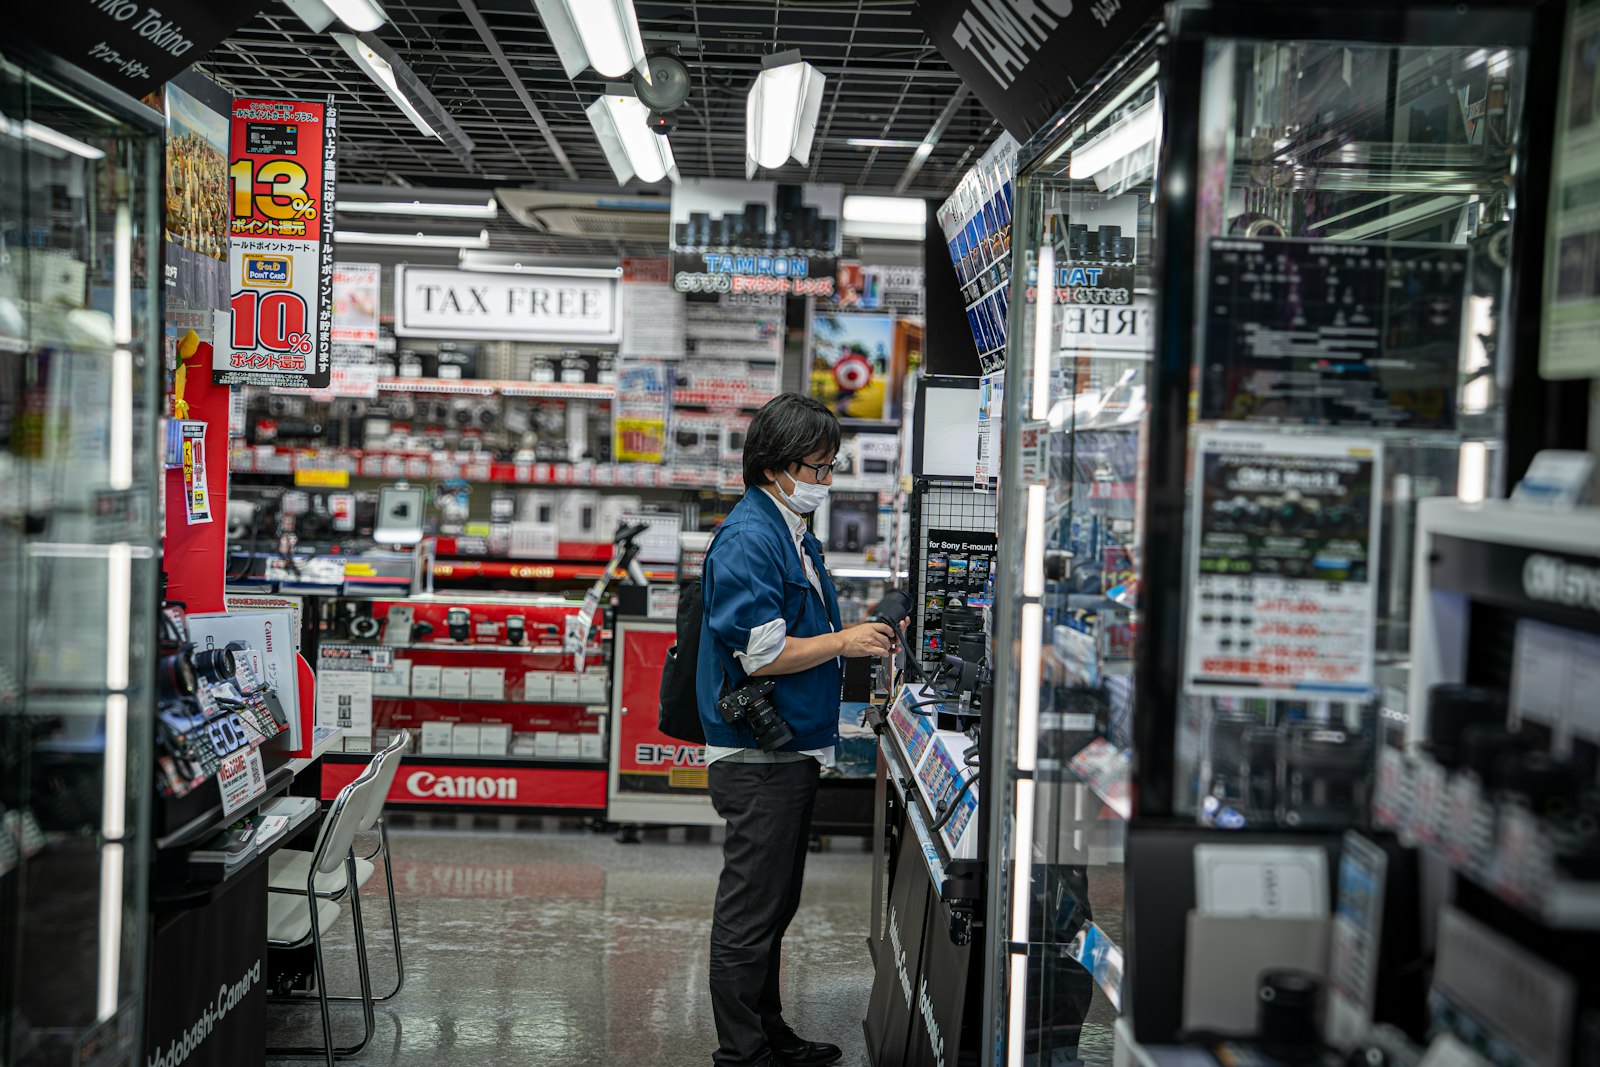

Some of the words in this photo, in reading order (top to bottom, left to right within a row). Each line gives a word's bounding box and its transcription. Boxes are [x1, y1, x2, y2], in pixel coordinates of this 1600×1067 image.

[132, 7, 194, 57] Tokina
[231, 218, 306, 236] ポイント還元
[230, 240, 310, 253] ールドポイントカード
[270, 272, 286, 280] CARD
[702, 253, 809, 277] TAMRON
[416, 283, 490, 315] TAX
[505, 286, 602, 320] FREE
[230, 352, 306, 371] ポイント還元
[929, 541, 940, 549] for
[941, 541, 960, 551] Sony
[961, 542, 993, 551] E-mount
[265, 620, 273, 653] Canon
[207, 714, 250, 757] EOS
[406, 770, 518, 800] Canon
